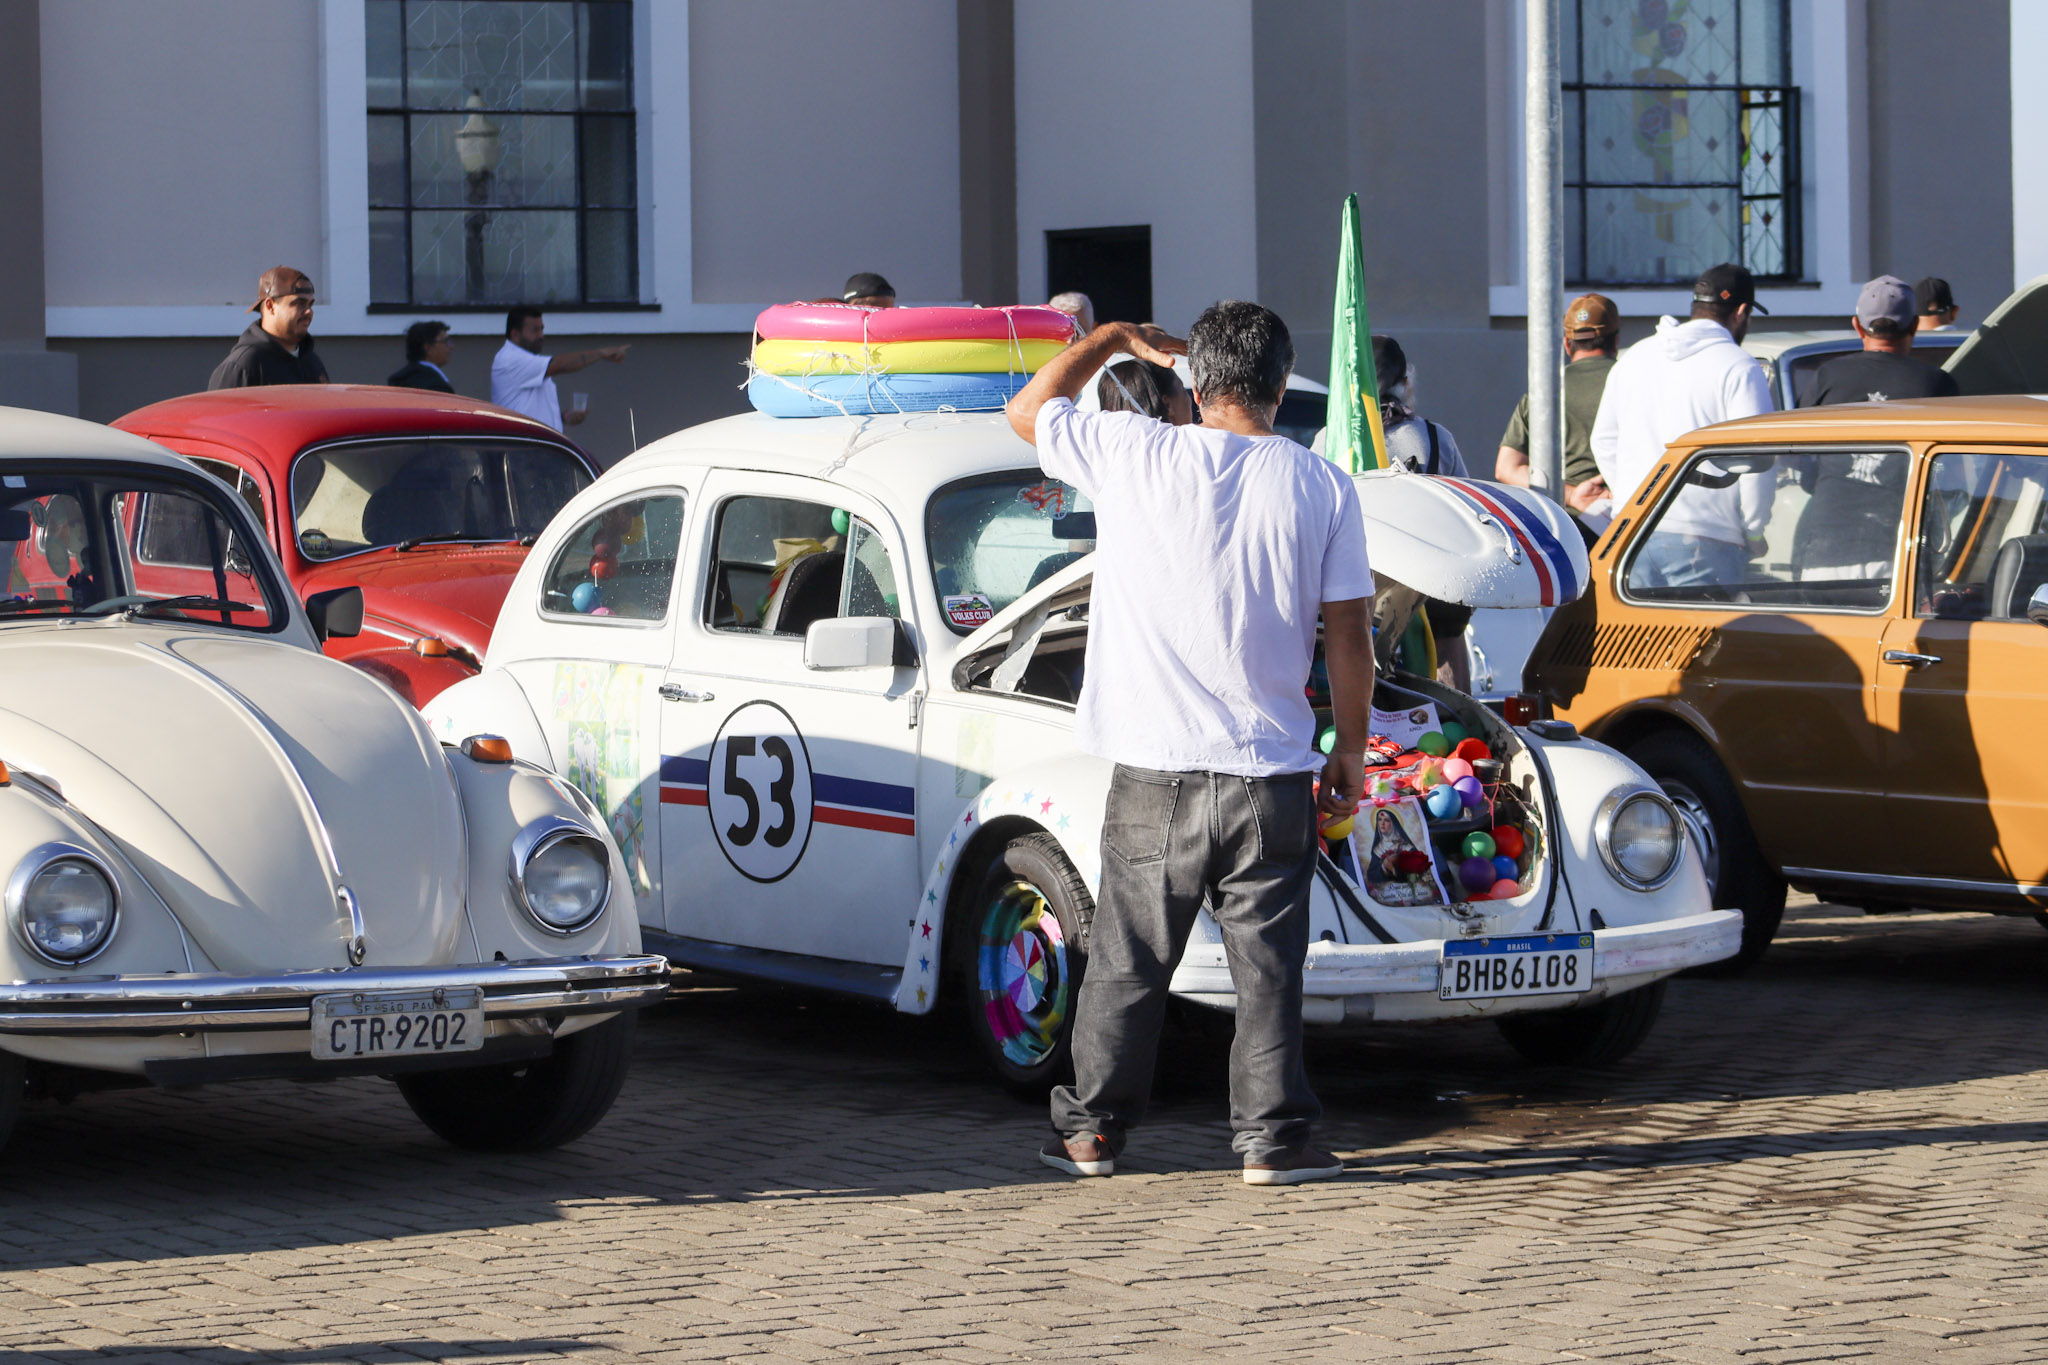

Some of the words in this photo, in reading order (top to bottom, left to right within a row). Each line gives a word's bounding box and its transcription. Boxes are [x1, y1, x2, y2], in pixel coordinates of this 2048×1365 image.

[951, 612, 974, 621] VOLKS
[974, 611, 992, 620] CLUB
[724, 735, 796, 848] 53
[1506, 942, 1532, 951] BRASIL
[1455, 953, 1578, 993] BHB6I08
[1442, 986, 1452, 997] BR
